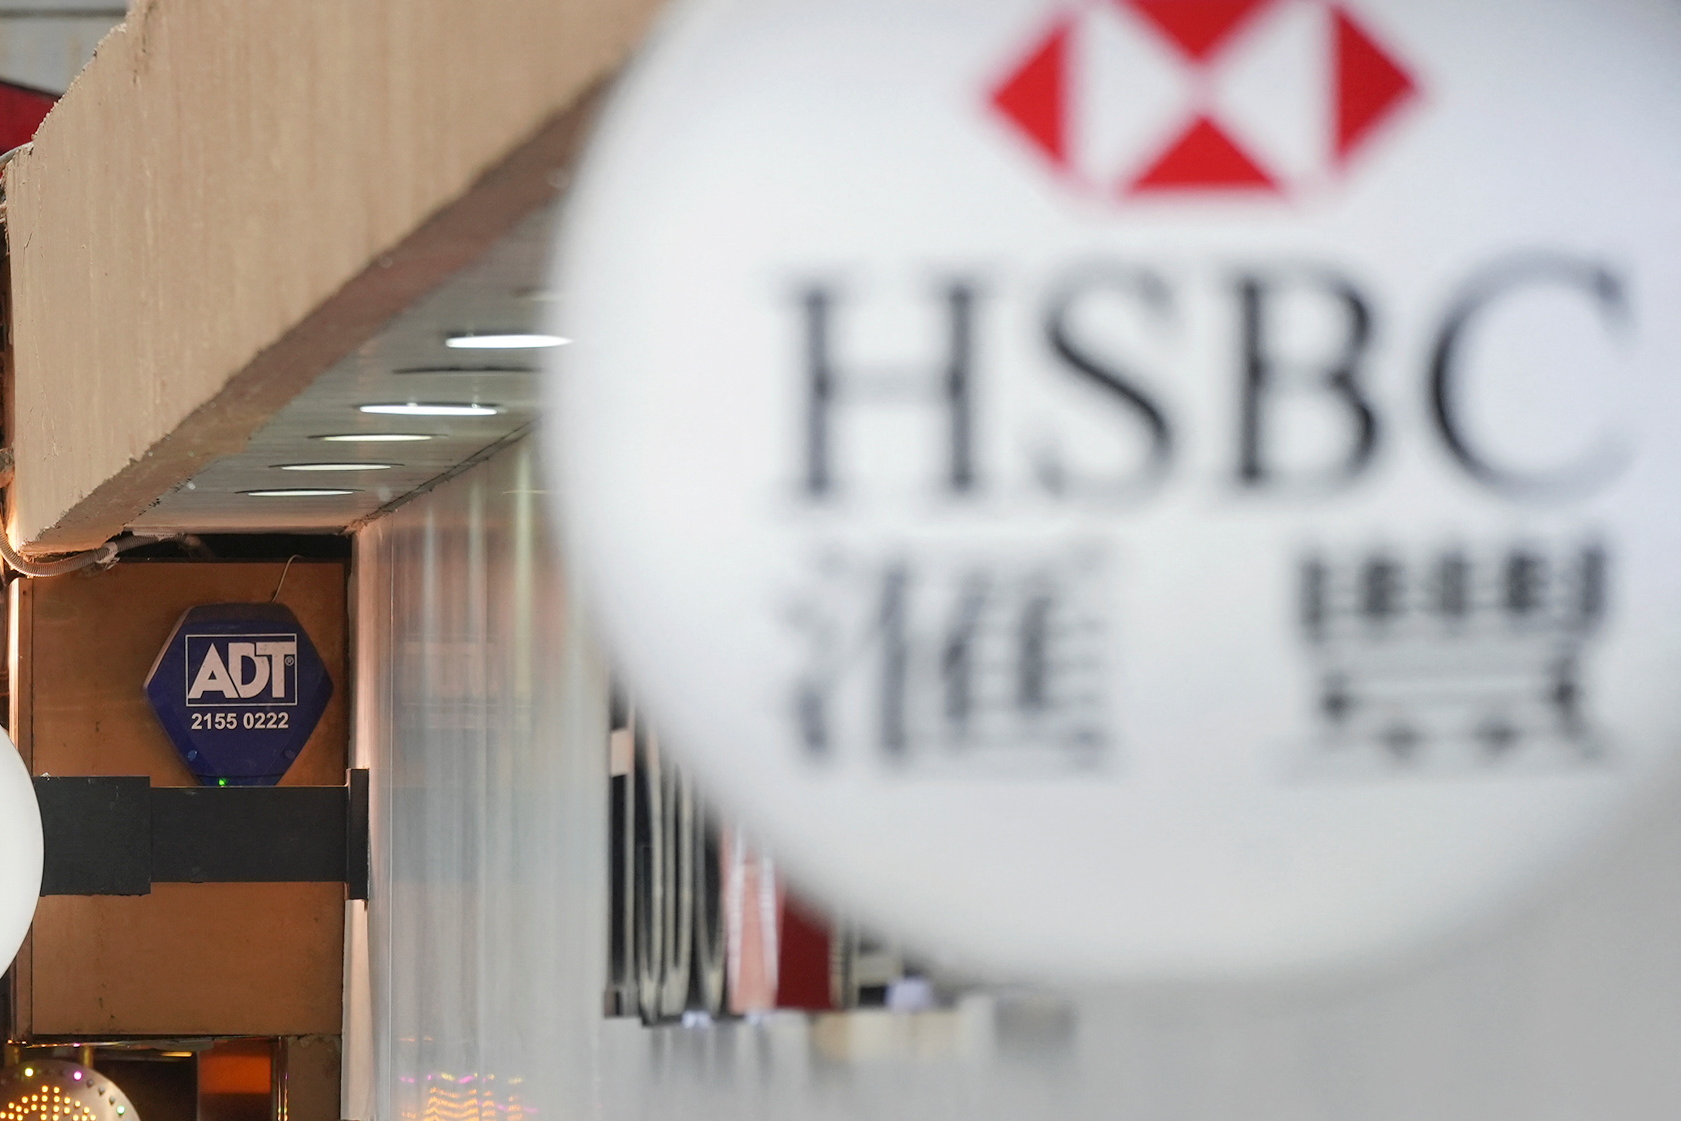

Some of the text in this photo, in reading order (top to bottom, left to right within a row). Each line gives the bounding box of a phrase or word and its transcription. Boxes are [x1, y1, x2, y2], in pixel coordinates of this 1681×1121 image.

[777, 242, 1635, 508] HSBC
[188, 641, 296, 699] ADT
[191, 712, 289, 730] 2155 0222
